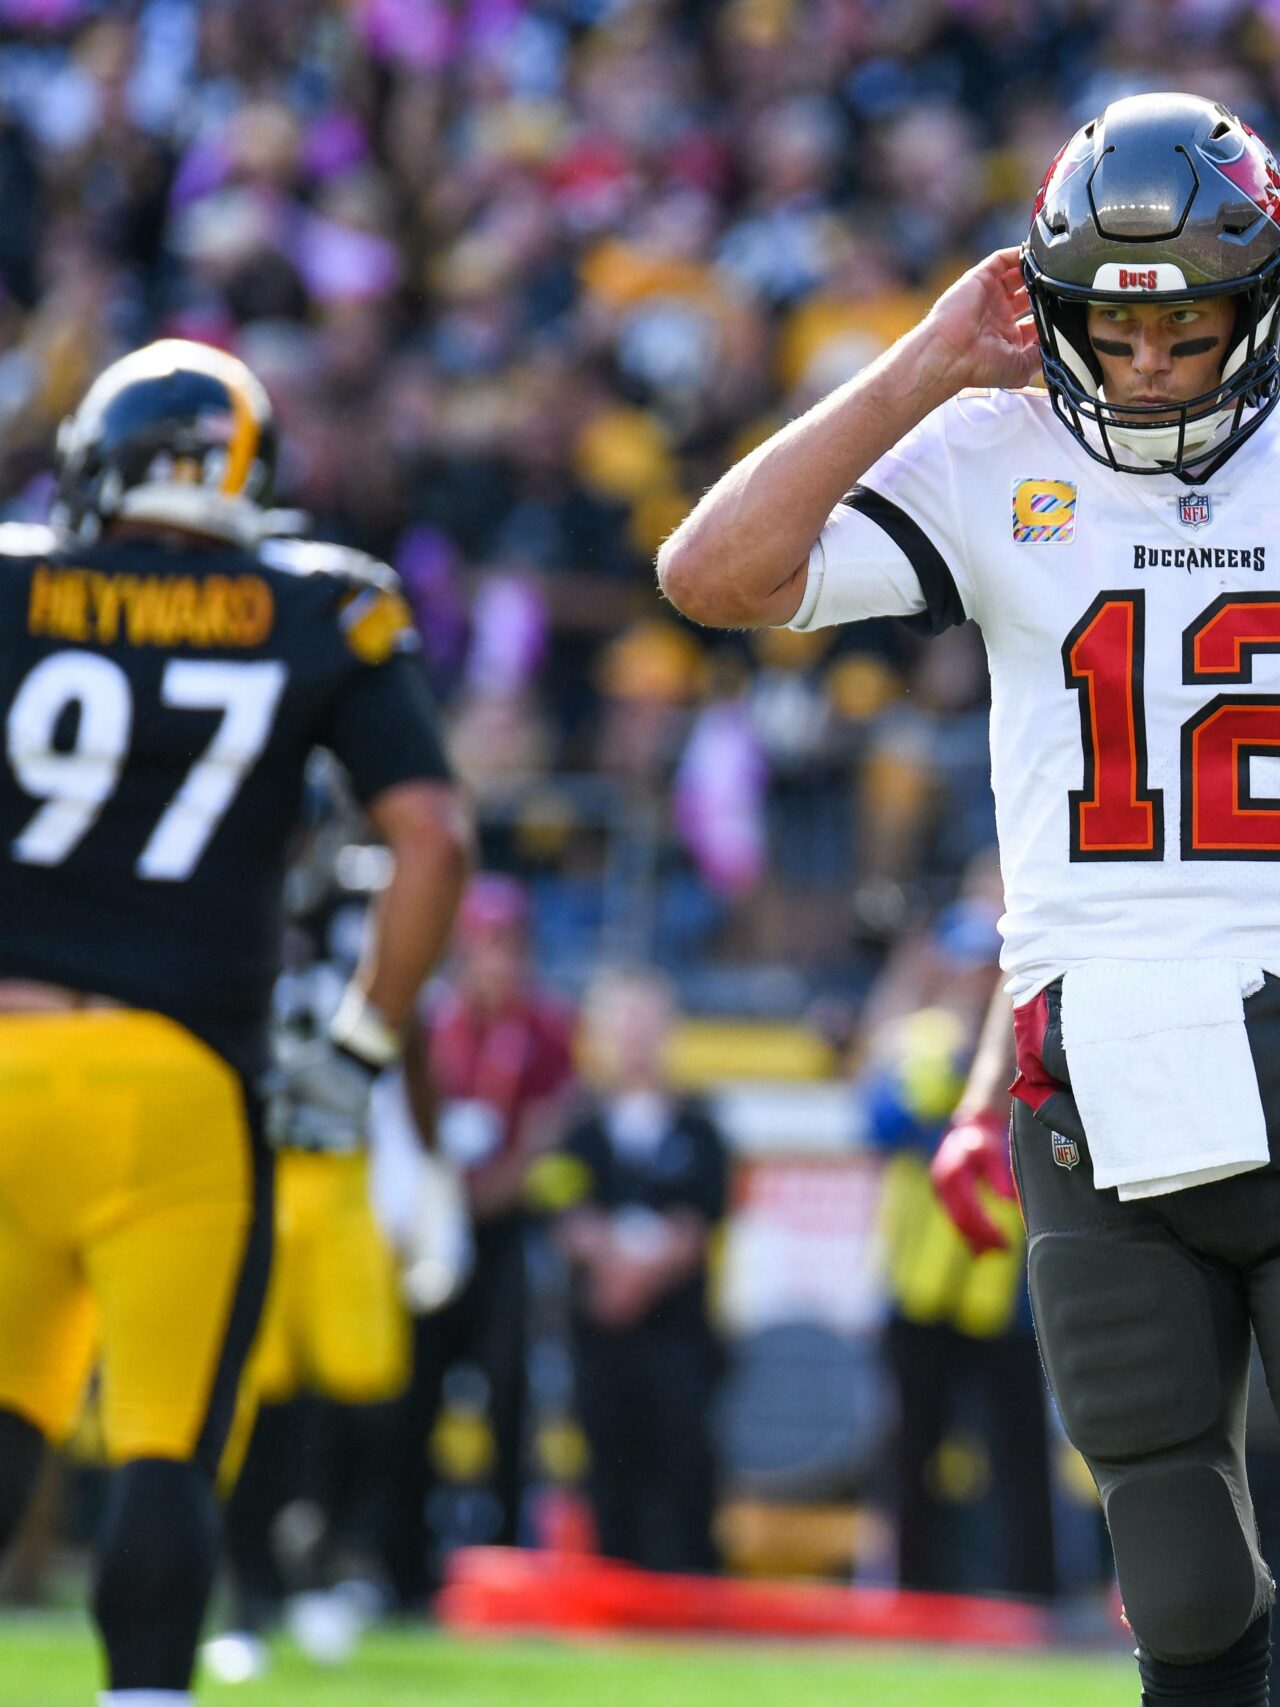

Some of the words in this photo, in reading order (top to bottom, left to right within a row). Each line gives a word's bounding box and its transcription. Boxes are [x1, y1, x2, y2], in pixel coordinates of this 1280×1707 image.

[1119, 269, 1157, 289] BUCS
[1015, 481, 1076, 526] C
[1182, 506, 1208, 521] NFL
[1133, 545, 1266, 574] BUCCANEERS
[27, 564, 275, 648] HEYWARD
[6, 648, 289, 882] 97
[1056, 1146, 1076, 1163] NFL
